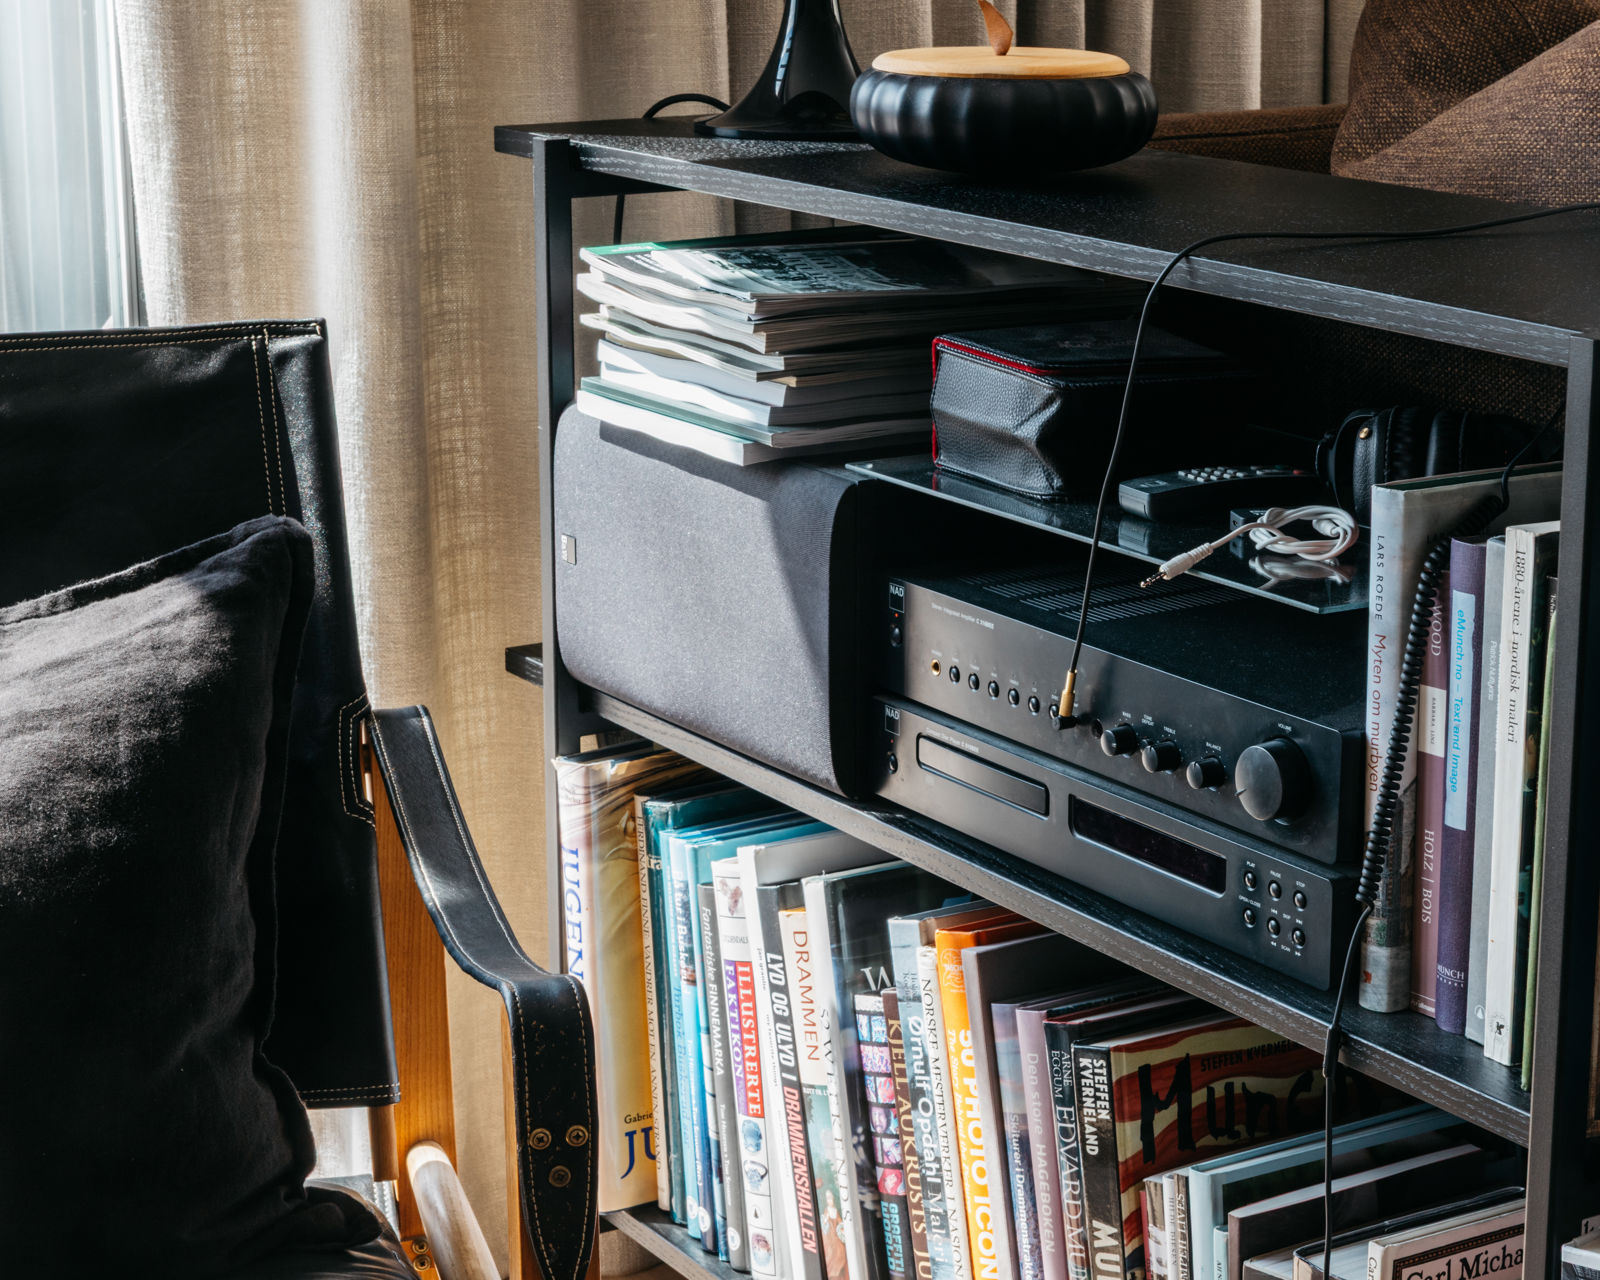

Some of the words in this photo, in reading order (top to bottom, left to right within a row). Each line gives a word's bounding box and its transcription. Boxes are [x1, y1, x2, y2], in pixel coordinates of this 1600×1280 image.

[1377, 535, 1385, 568] LARS
[889, 585, 904, 597] NAD
[1374, 575, 1384, 621] ROEDE
[1513, 549, 1526, 626] 1880-årene
[1430, 604, 1443, 656] WOOD
[1454, 609, 1465, 681] eMunch.no
[1372, 633, 1387, 684] Myten
[1509, 639, 1521, 695] nordisk
[885, 707, 900, 720] NAD
[1277, 723, 1292, 732] VOLUME
[1372, 691, 1382, 716] om
[1454, 697, 1464, 724] Text
[1507, 699, 1521, 744] maleri
[1369, 721, 1383, 792] murbyen
[1452, 726, 1464, 751] and
[1450, 754, 1463, 793] Image
[1246, 860, 1256, 868] PLAY
[1423, 829, 1435, 872] HOLZ
[1295, 880, 1306, 888] STOP
[1421, 887, 1433, 925] BOIS
[701, 907, 716, 983] Fantastiske
[765, 952, 785, 986] LYD
[725, 965, 744, 1077] FAKTIKON
[772, 993, 790, 1017] OG
[793, 930, 821, 1061] DRAMMEN
[708, 984, 725, 1077] FINNEMARKA
[737, 966, 761, 1116] ILLUSTRERTE
[775, 1024, 797, 1068] ULYD
[907, 1015, 932, 1088] Ørnulf
[782, 1072, 797, 1082] I
[921, 978, 939, 1050] NORSKE
[930, 1056, 954, 1188] MESTERVERKER
[1026, 1052, 1040, 1086] Den
[1051, 1050, 1063, 1099] EGGUM
[1062, 1051, 1073, 1087] ARNE
[1200, 1050, 1244, 1073] STEFFEN
[1031, 1092, 1043, 1136] store
[1079, 1057, 1099, 1156] KVERNELAND
[1093, 1058, 1111, 1120] STEFFEN
[887, 1018, 907, 1090] KJELL
[898, 1096, 927, 1235] AUKRUSTS
[917, 1097, 942, 1184] Opdahl
[963, 1075, 990, 1186] PHOTO
[1009, 1113, 1023, 1167] Skiturer
[783, 1086, 817, 1253] DRAMMENSHALLEN
[1056, 1105, 1083, 1220] EDVARD
[1035, 1143, 1056, 1253] HAGEBOKEN
[879, 1199, 897, 1270] WORLD
[888, 1202, 905, 1273] GRAFFITI
[926, 1184, 948, 1264] Maleri
